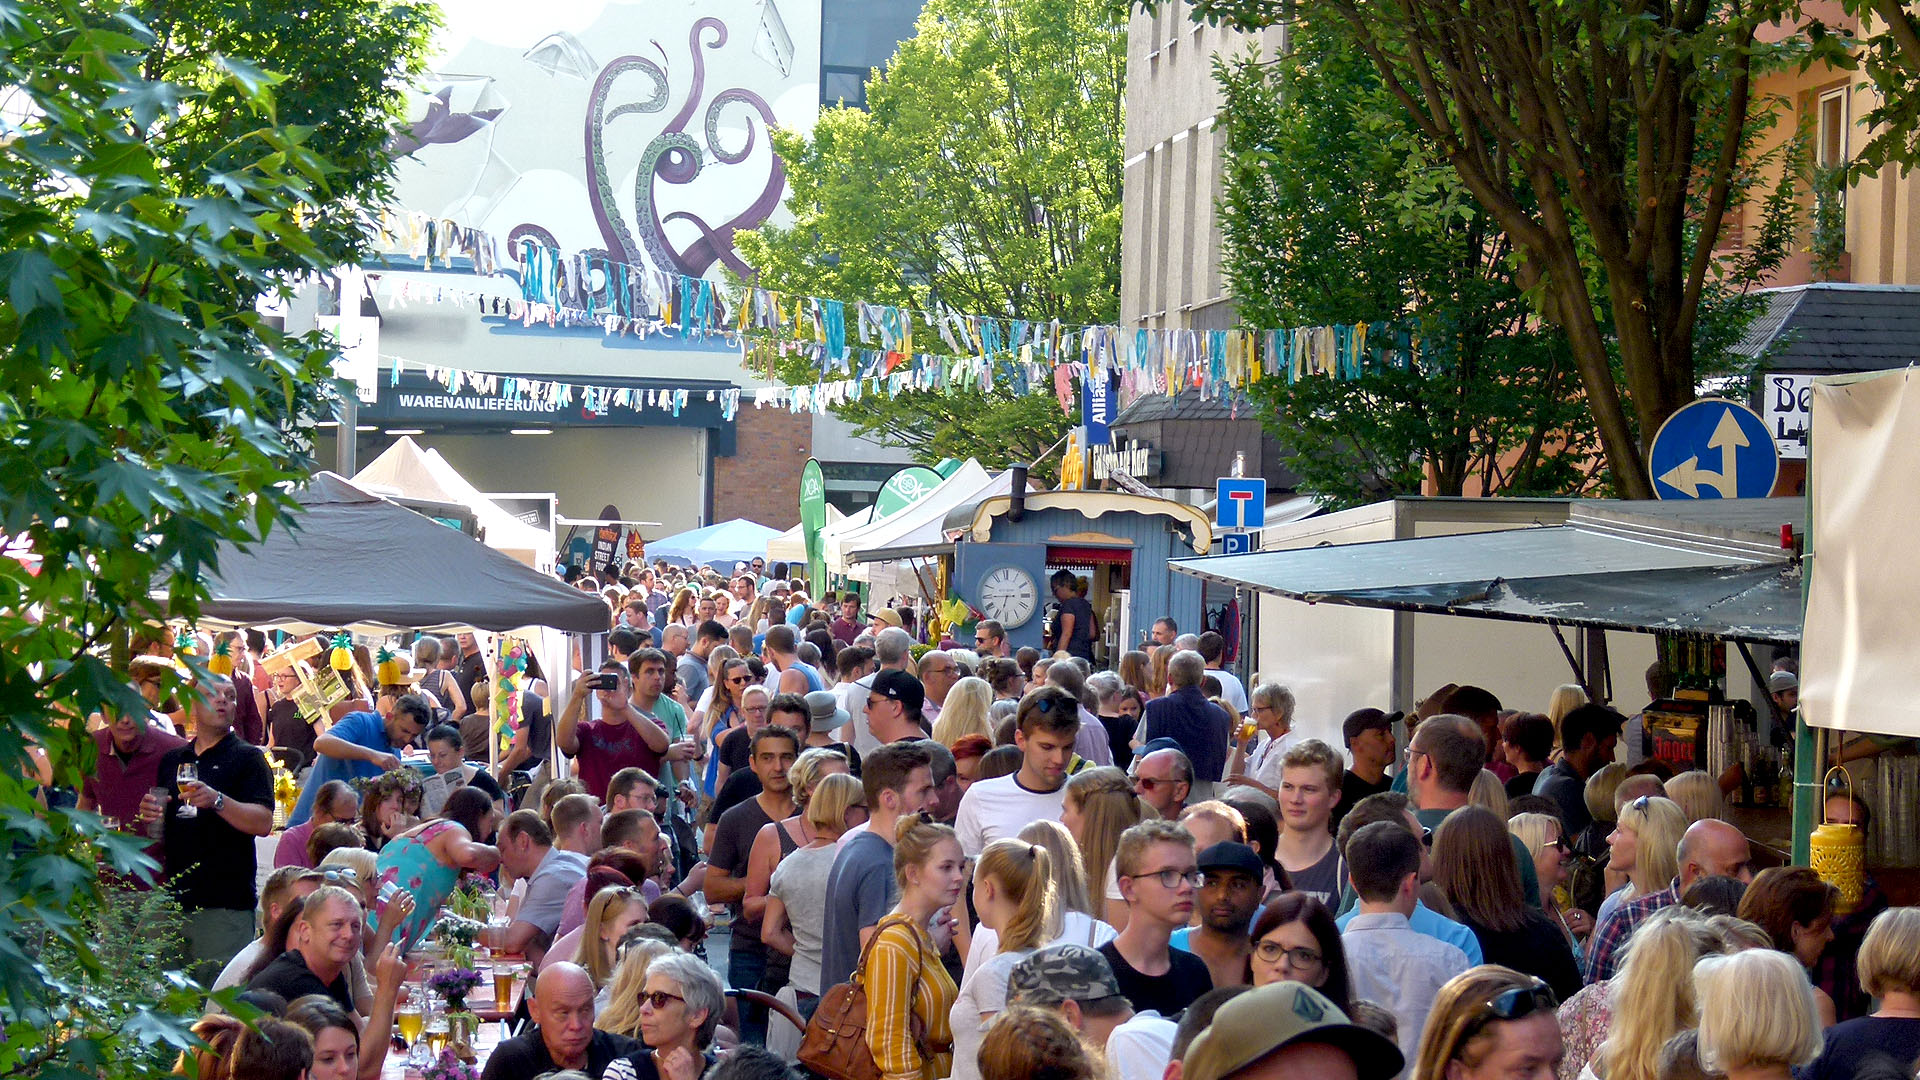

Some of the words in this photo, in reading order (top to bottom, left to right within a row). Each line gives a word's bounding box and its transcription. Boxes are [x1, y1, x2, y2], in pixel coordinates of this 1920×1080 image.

[399, 394, 555, 413] WARENANLIEFERUNG
[1226, 538, 1239, 553] P
[594, 551, 610, 562] STREET
